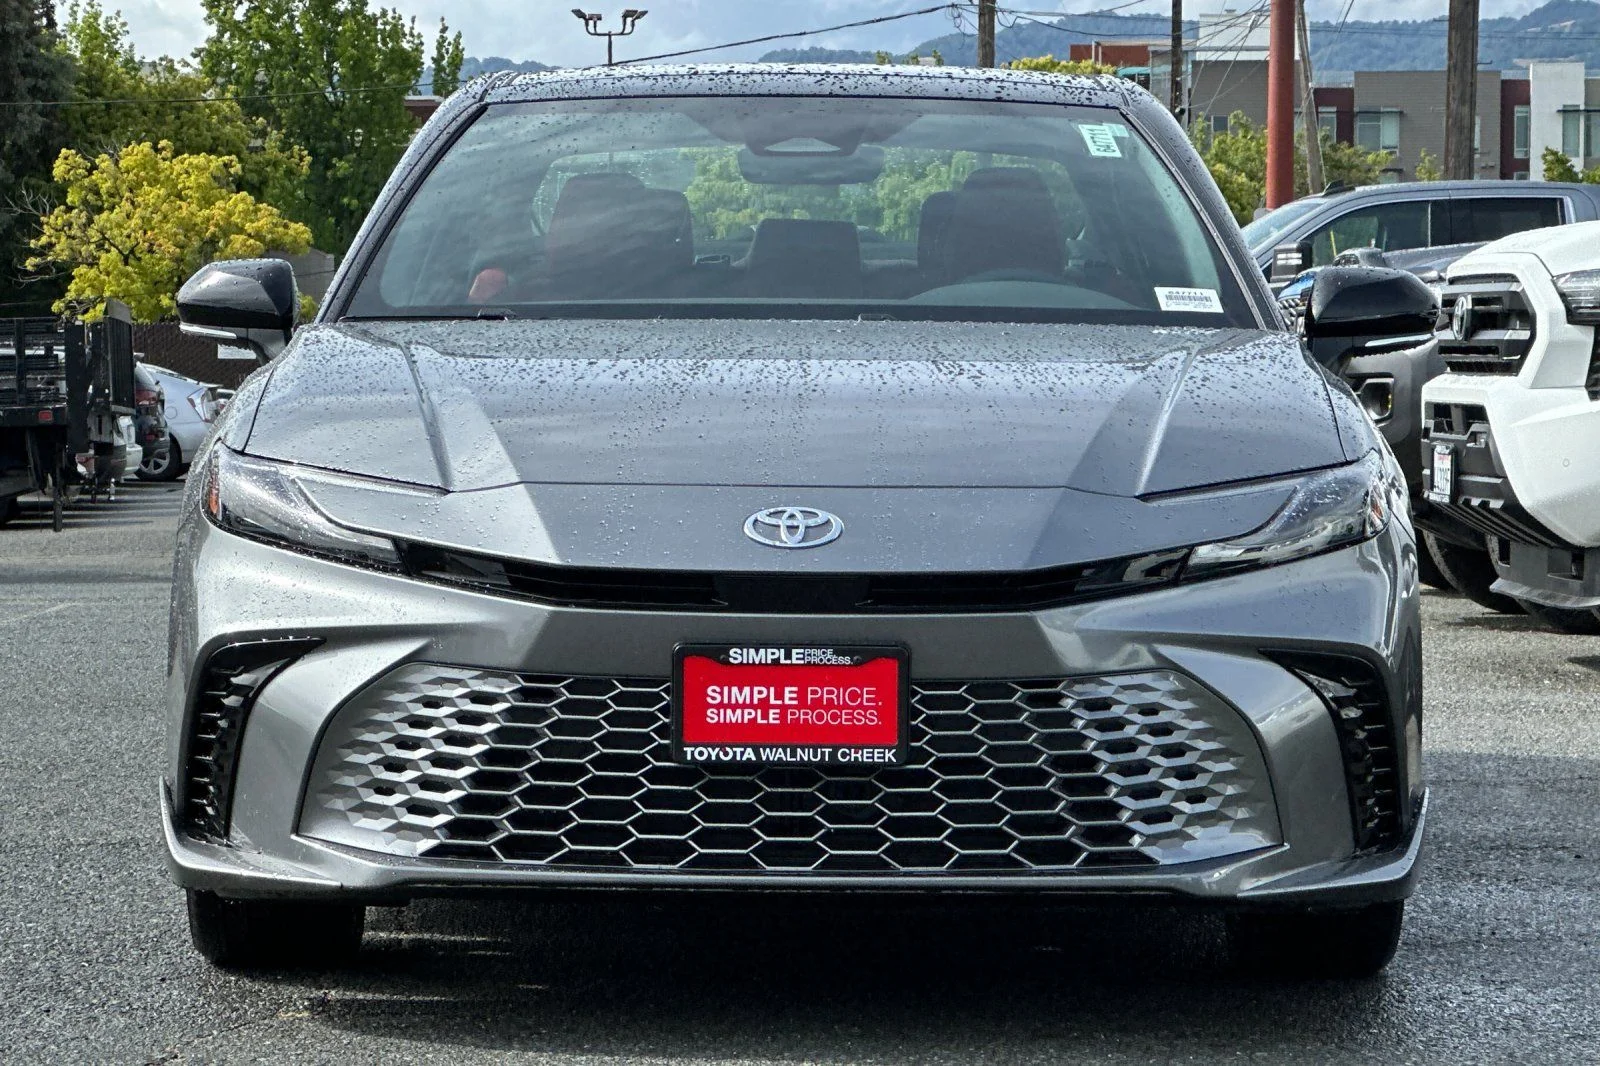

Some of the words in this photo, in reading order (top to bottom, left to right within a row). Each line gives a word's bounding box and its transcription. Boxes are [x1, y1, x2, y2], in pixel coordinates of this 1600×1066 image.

[729, 648, 804, 665] SIMPLE
[804, 656, 854, 665] PROCESS.
[706, 686, 799, 705] SIMPLE
[807, 687, 883, 706] PRICE.
[706, 709, 780, 724] SIMPLE
[787, 710, 882, 725] PROCESS.
[683, 747, 757, 761] TOYOTA
[759, 748, 832, 762] WALNUT
[837, 748, 897, 763] CREEK
